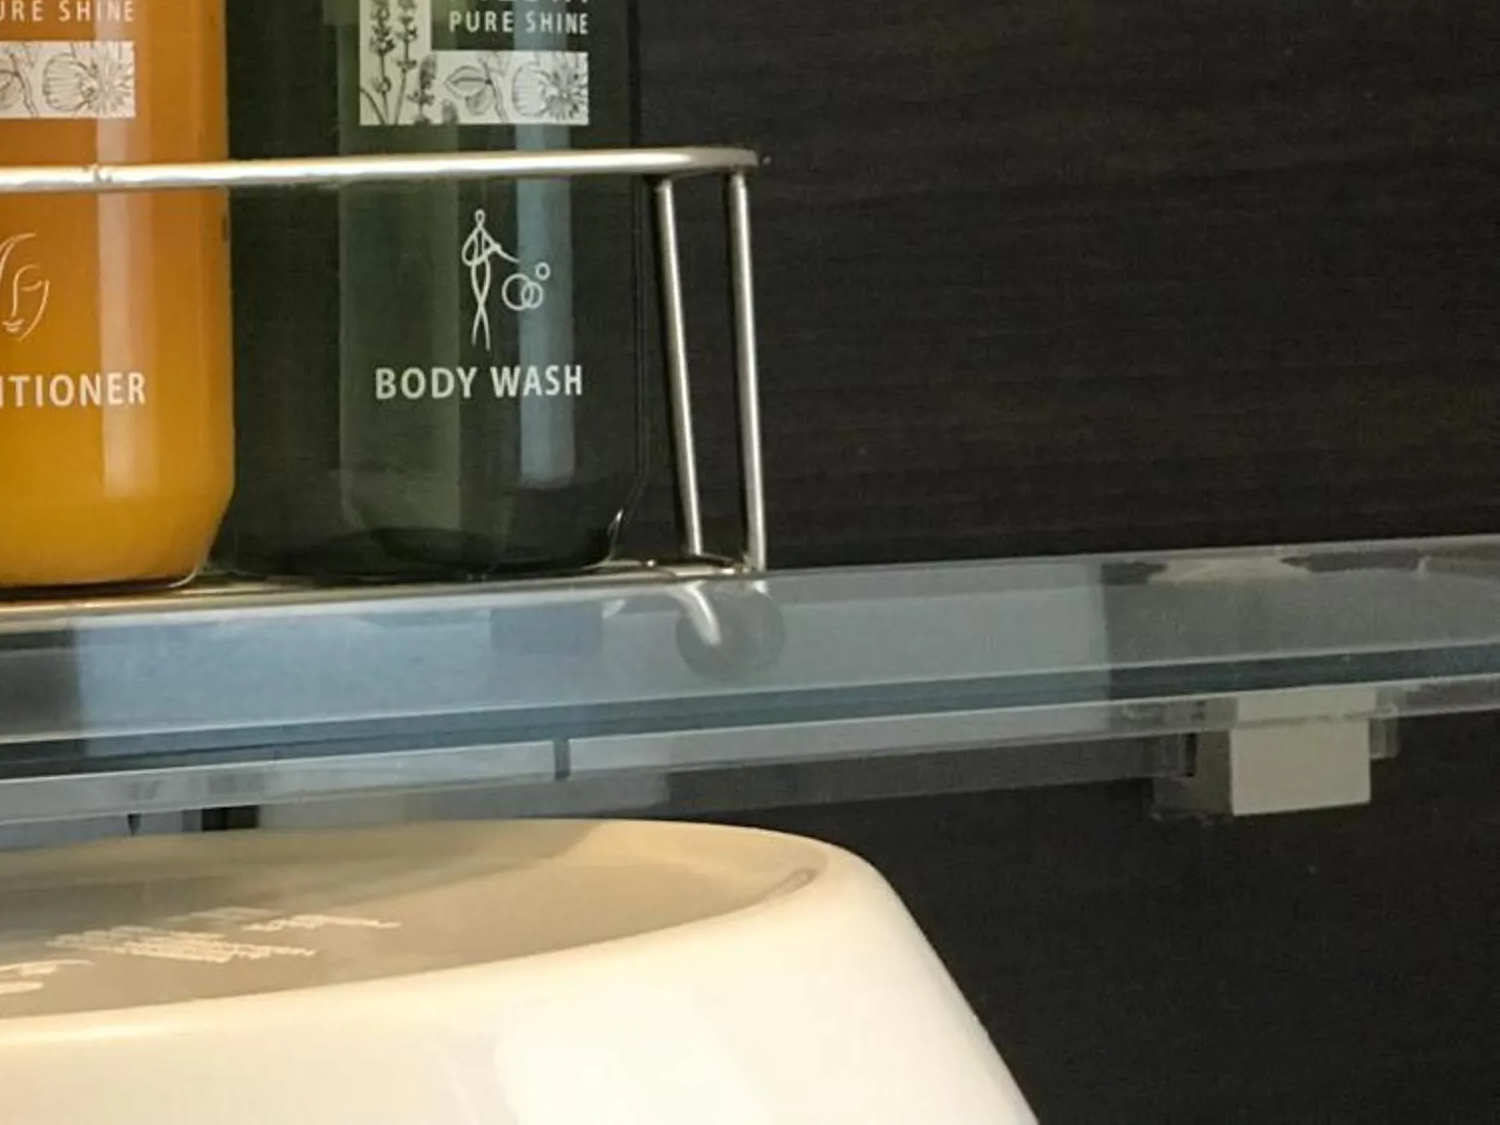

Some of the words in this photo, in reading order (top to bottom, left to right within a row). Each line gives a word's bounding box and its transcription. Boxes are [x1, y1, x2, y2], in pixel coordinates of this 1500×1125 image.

[58, 0, 135, 23] SHINE
[449, 10, 514, 33] PURE
[525, 10, 589, 35] SHINE
[375, 366, 479, 400] BODY
[490, 364, 583, 399] WASH
